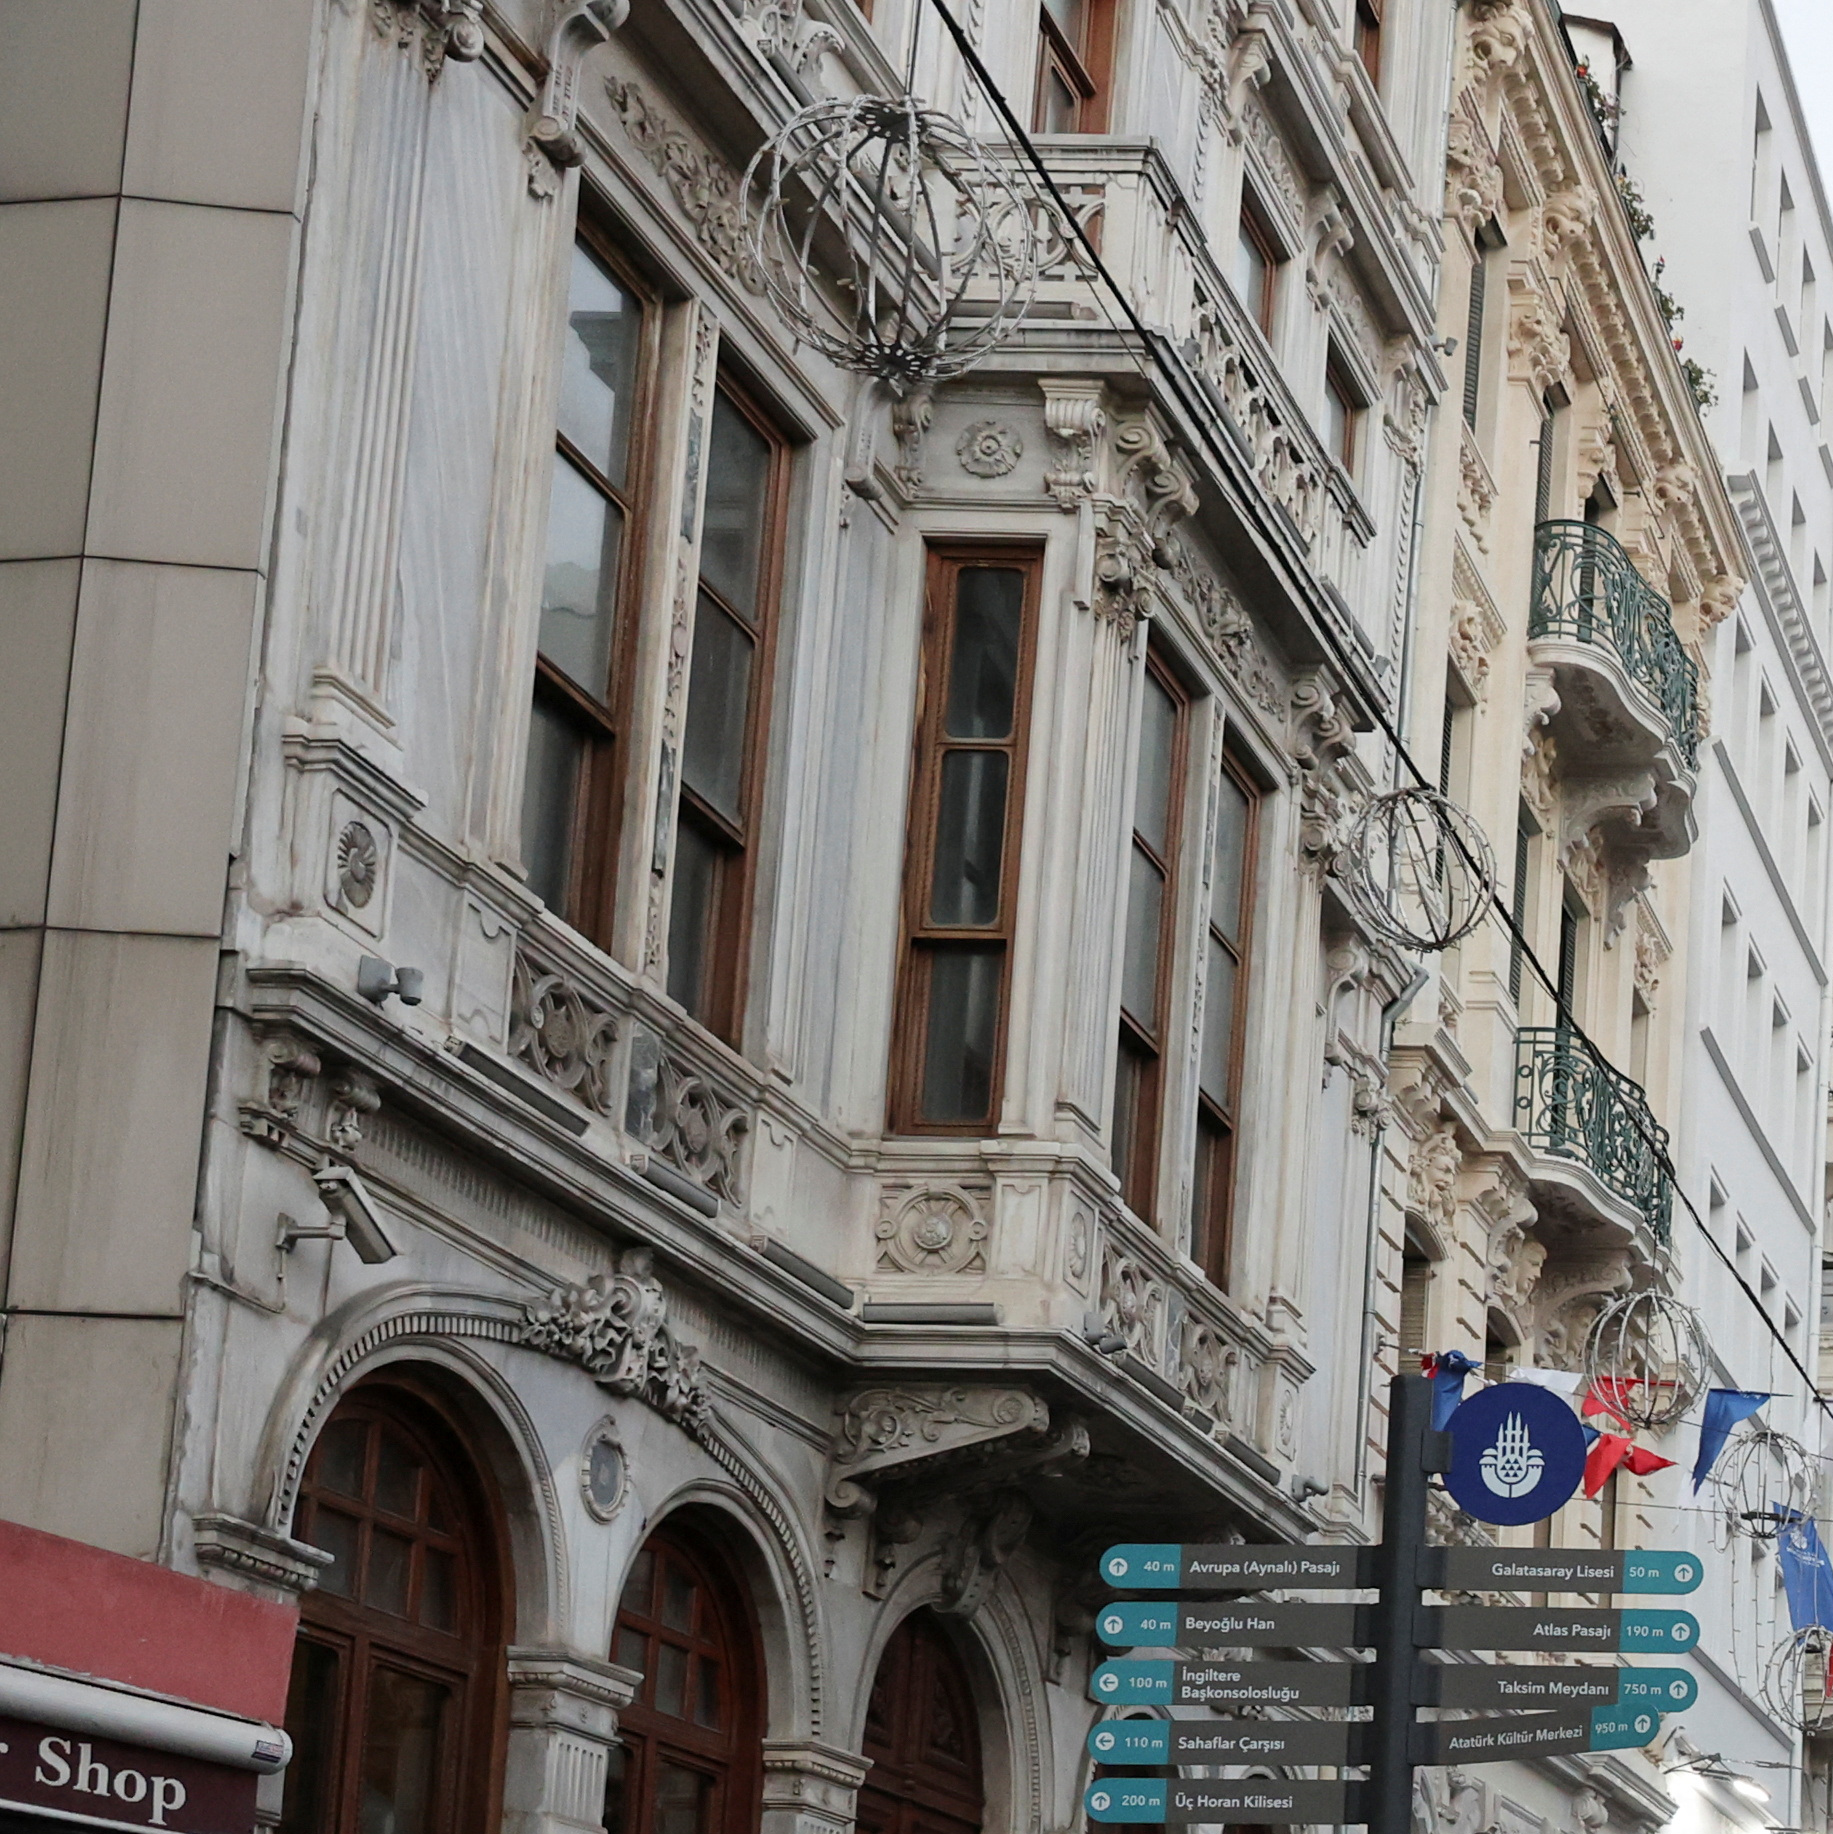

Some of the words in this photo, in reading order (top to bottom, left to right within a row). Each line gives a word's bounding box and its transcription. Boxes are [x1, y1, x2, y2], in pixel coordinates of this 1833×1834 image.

[1144, 1561, 1160, 1573] 40
[1163, 1564, 1175, 1572] m
[1189, 1561, 1240, 1576] Avrupa
[1243, 1561, 1298, 1576] (Aynalı)
[1301, 1562, 1340, 1576] Pasajı
[1492, 1563, 1573, 1580] Galatasaray
[1577, 1566, 1614, 1578] Lisesi
[1629, 1567, 1645, 1578] 50
[1648, 1570, 1660, 1578] m
[1140, 1619, 1156, 1630] 40
[1160, 1622, 1171, 1630] m
[1186, 1617, 1243, 1632] Beyoğlu
[1247, 1618, 1275, 1630] Han
[1533, 1624, 1568, 1636] Atlas
[1572, 1625, 1611, 1640] Pasajı
[1626, 1626, 1649, 1637] 190
[1652, 1629, 1664, 1637] m
[1129, 1677, 1153, 1688] 100
[1156, 1680, 1167, 1688] m
[1182, 1667, 1241, 1684] İngiltere
[1181, 1687, 1299, 1702] Başkonsolosluğu
[1498, 1681, 1545, 1694] Taksim
[1549, 1683, 1609, 1697] Meydanı
[1624, 1684, 1647, 1695] 750
[1650, 1687, 1662, 1695] m
[1595, 1723, 1616, 1733] 950
[1618, 1723, 1628, 1732] m
[1124, 1737, 1148, 1748] 110
[1151, 1739, 1163, 1748] m
[1178, 1737, 1236, 1750] Sahaflar
[1239, 1738, 1285, 1753] Çarşısı
[1449, 1734, 1494, 1750] Atatürk
[1497, 1731, 1534, 1746] Kültür
[1536, 1725, 1583, 1742] Merkezi
[35, 1736, 187, 1825] Shop
[1122, 1795, 1146, 1806] 200
[1149, 1797, 1160, 1806] m
[1175, 1793, 1194, 1810] Üç
[1198, 1796, 1240, 1808] Horan
[1244, 1796, 1293, 1809] Kilisesi
